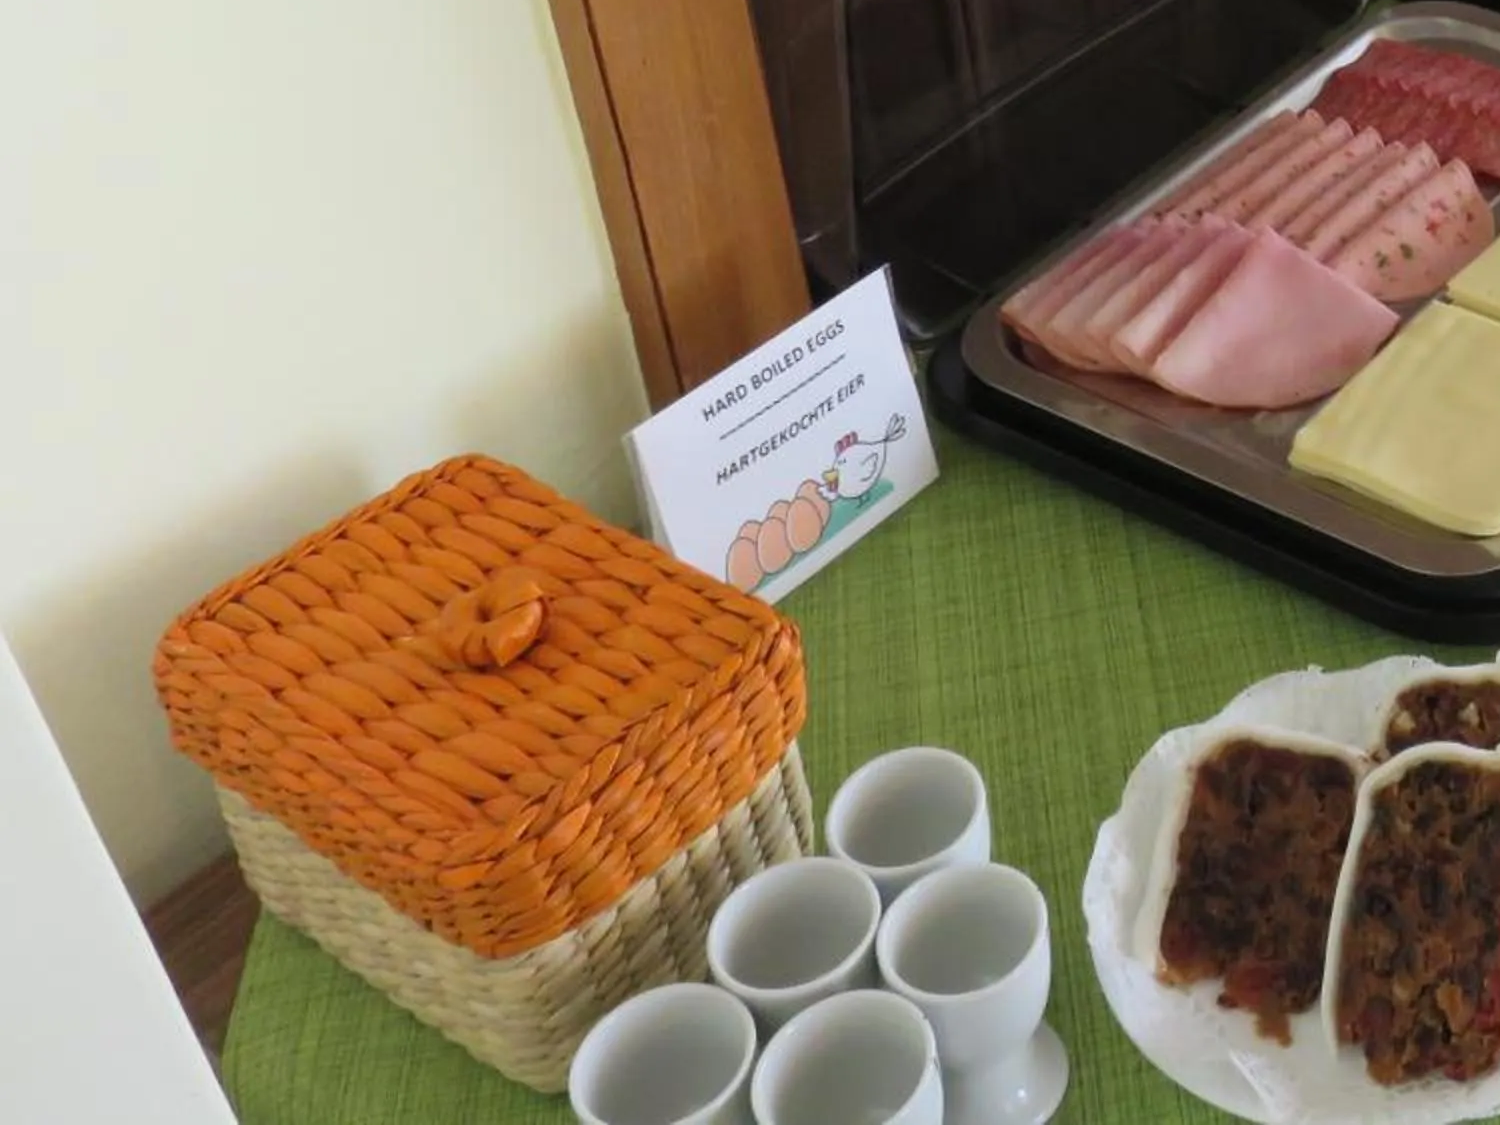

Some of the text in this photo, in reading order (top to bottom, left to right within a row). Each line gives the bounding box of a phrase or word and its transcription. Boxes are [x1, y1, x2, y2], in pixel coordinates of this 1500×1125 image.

[702, 319, 845, 422] HARD BOILED EGGS
[716, 373, 865, 485] HARTGEKOCHTE EIER
